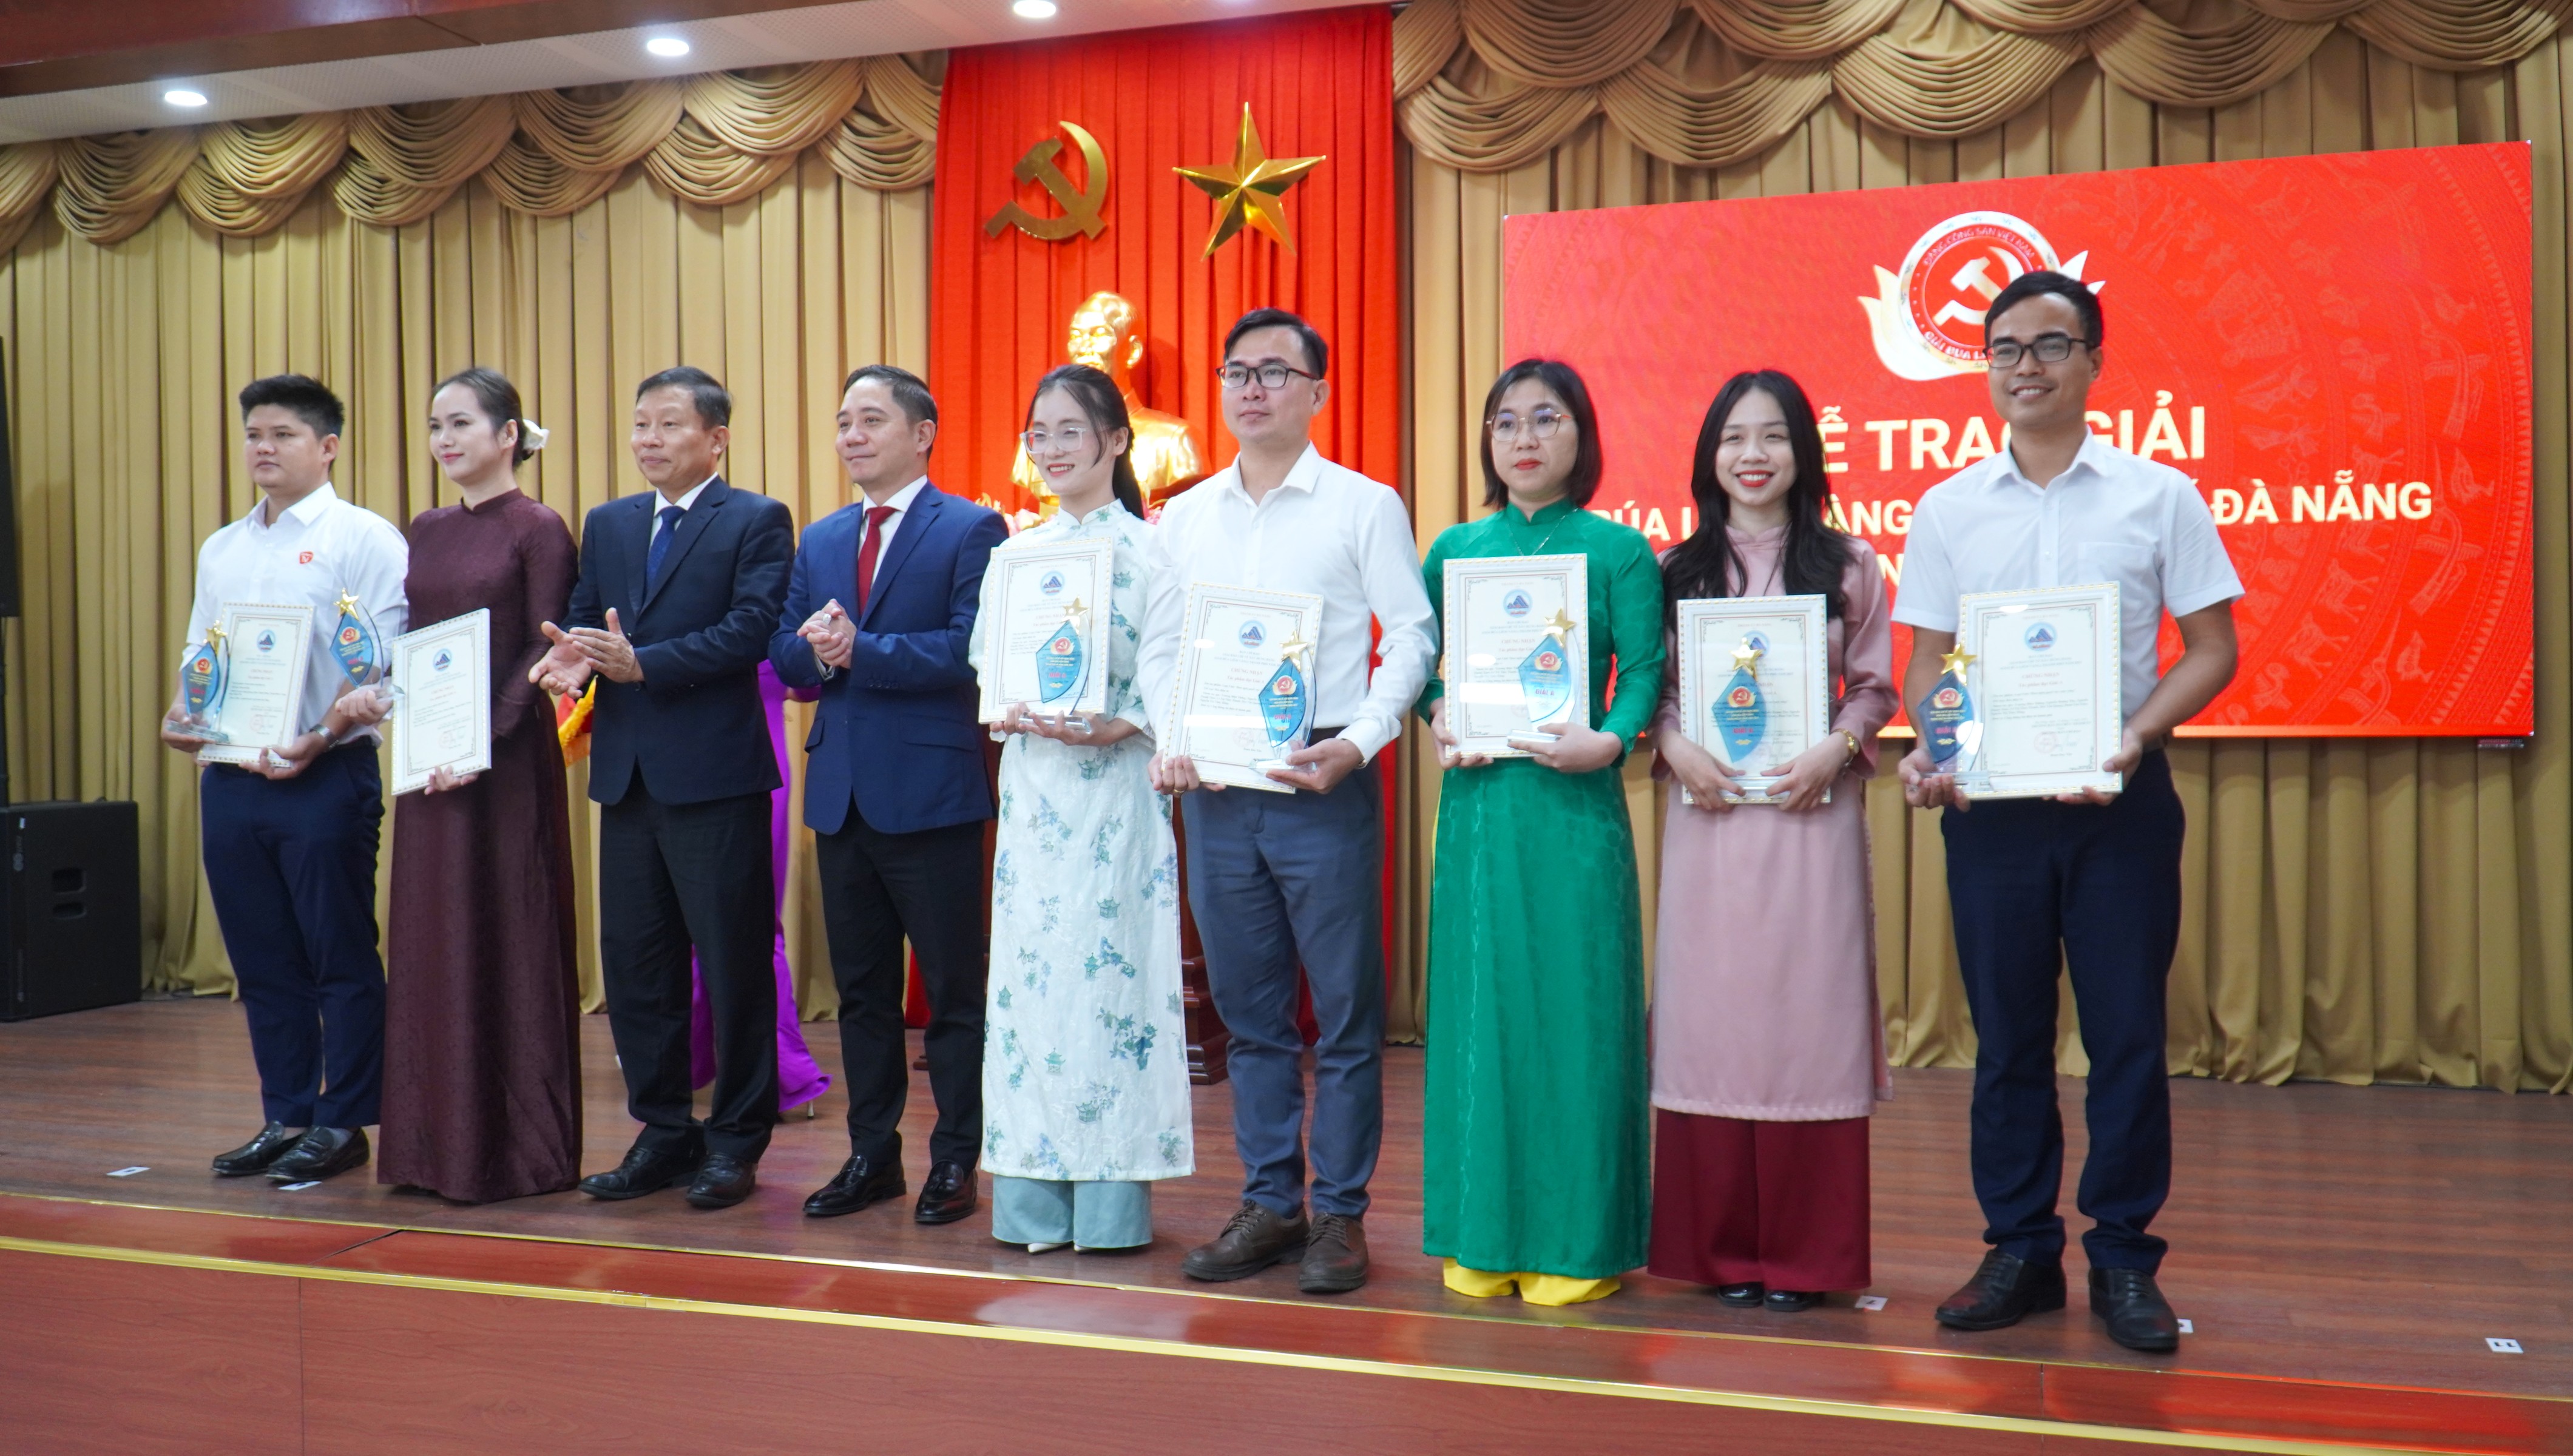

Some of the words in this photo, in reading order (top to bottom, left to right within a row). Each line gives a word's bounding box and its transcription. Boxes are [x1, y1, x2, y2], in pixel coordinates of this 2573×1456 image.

[1817, 405, 1848, 473] Ễ
[1864, 416, 2011, 471] TRA
[1591, 500, 1671, 541] ÚA
[1823, 493, 1913, 536] ÀNG
[2210, 479, 2279, 525] ĐÀ
[2292, 470, 2432, 524] NẴNG
